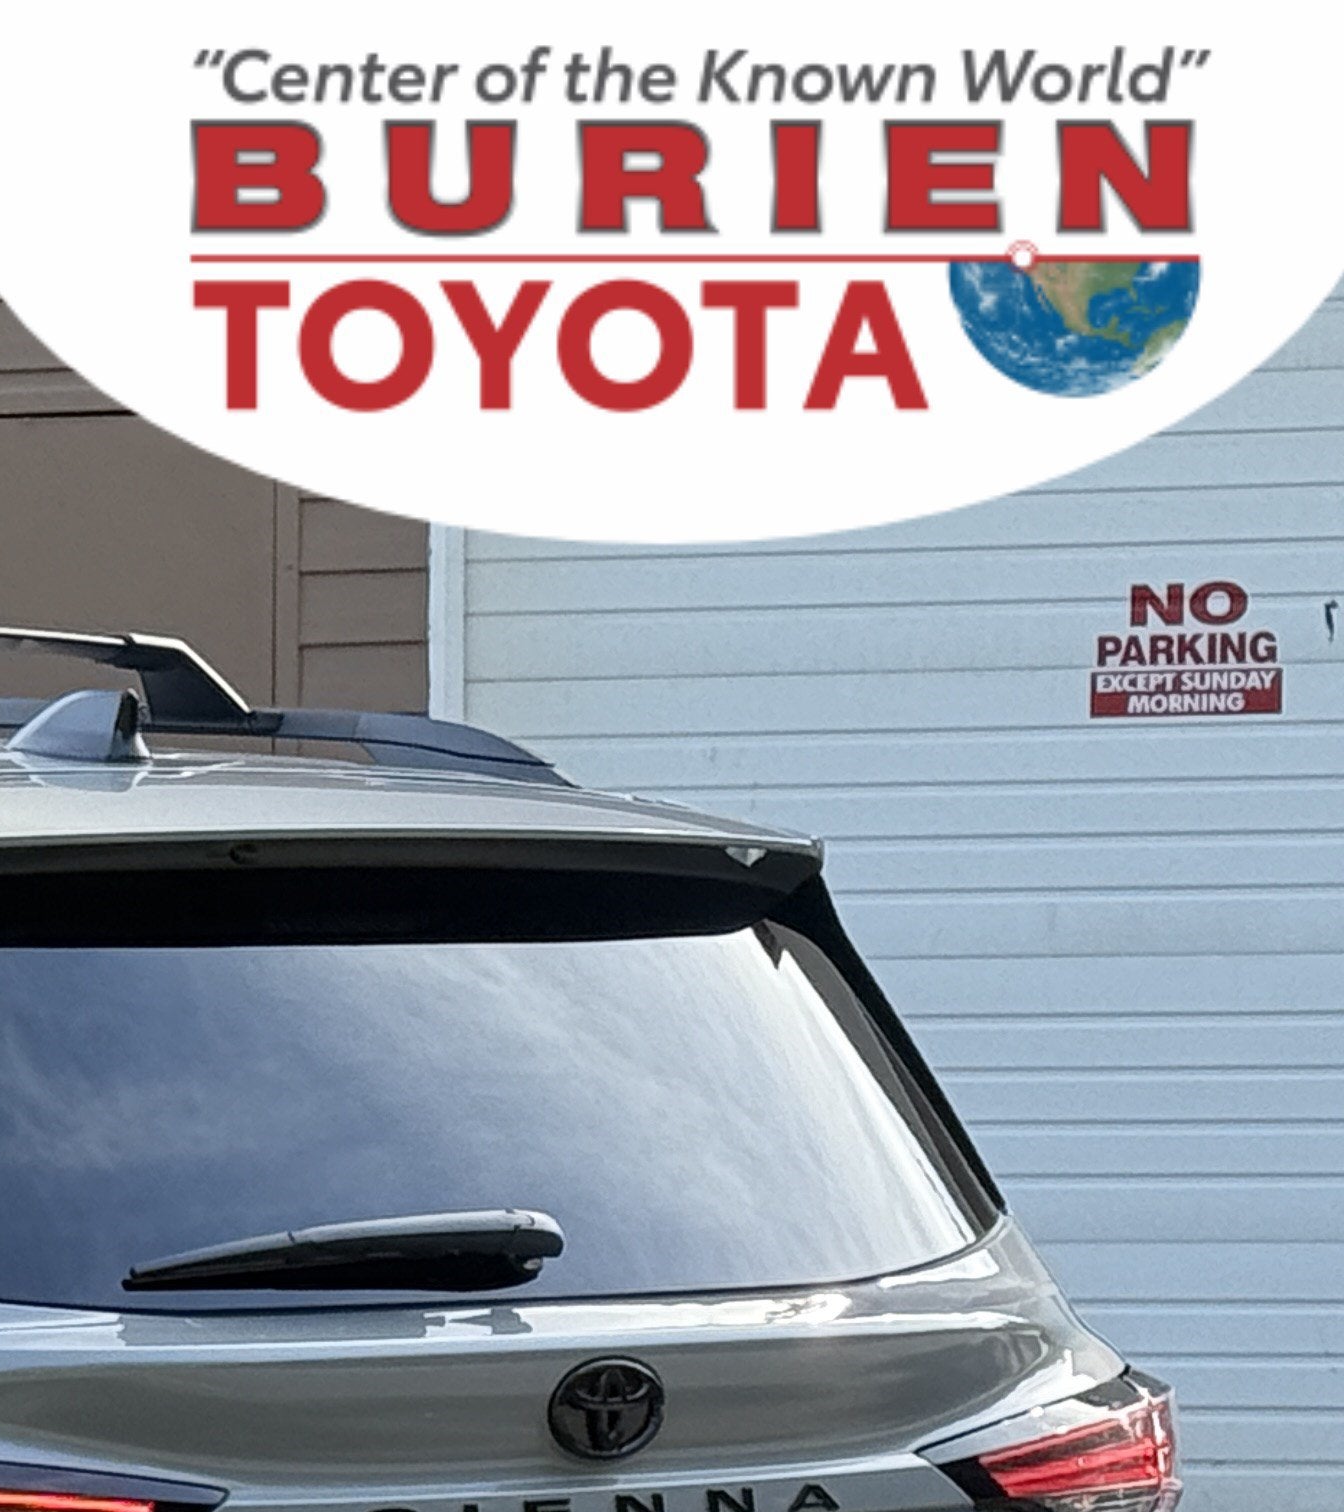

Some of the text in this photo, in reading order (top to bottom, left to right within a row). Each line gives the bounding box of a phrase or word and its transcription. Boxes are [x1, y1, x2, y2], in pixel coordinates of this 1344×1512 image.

[1129, 580, 1249, 628] NO
[1096, 631, 1278, 668] PARKING
[1095, 670, 1277, 693] EXCEPT SUNDAY
[1127, 692, 1246, 714] MORNING
